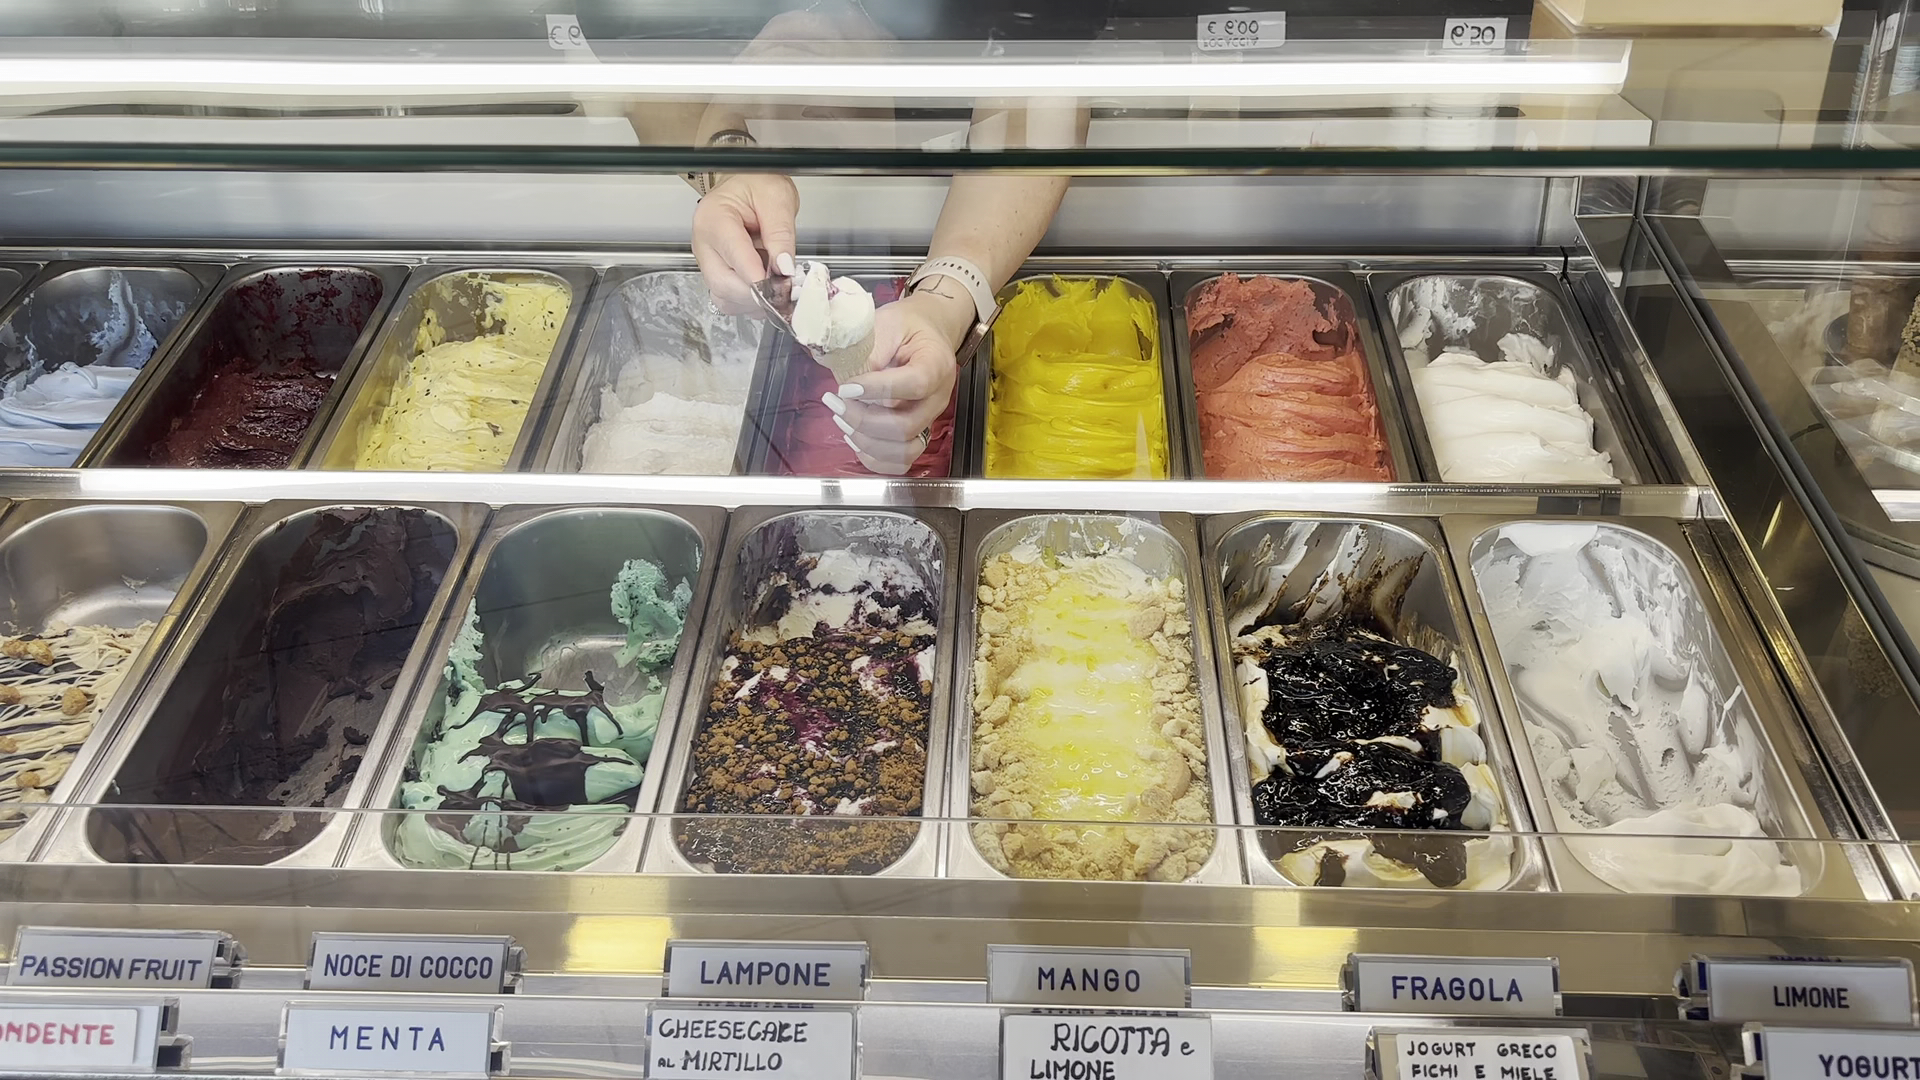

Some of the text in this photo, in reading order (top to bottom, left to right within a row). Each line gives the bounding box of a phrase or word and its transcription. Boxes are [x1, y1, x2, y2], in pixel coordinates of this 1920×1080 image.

[19, 955, 202, 981] PASSION FRUIT
[324, 954, 493, 980] NOCE DI COCCO
[701, 961, 831, 987] LAMPONE
[1038, 968, 1141, 993] MANGO
[1391, 976, 1523, 1003] FRAGOLA
[1774, 986, 1849, 1009] LIMONE
[0, 1022, 115, 1045] NDENTE
[329, 1026, 445, 1052] MENTA
[658, 1019, 808, 1043] CHEESECAKE
[1051, 1023, 1171, 1056] RICOTTA
[658, 1050, 782, 1072] AL MIRTILLO
[1407, 1041, 1557, 1059] JOGURT GRECO
[1411, 1063, 1557, 1080] FICHI E MIELE
